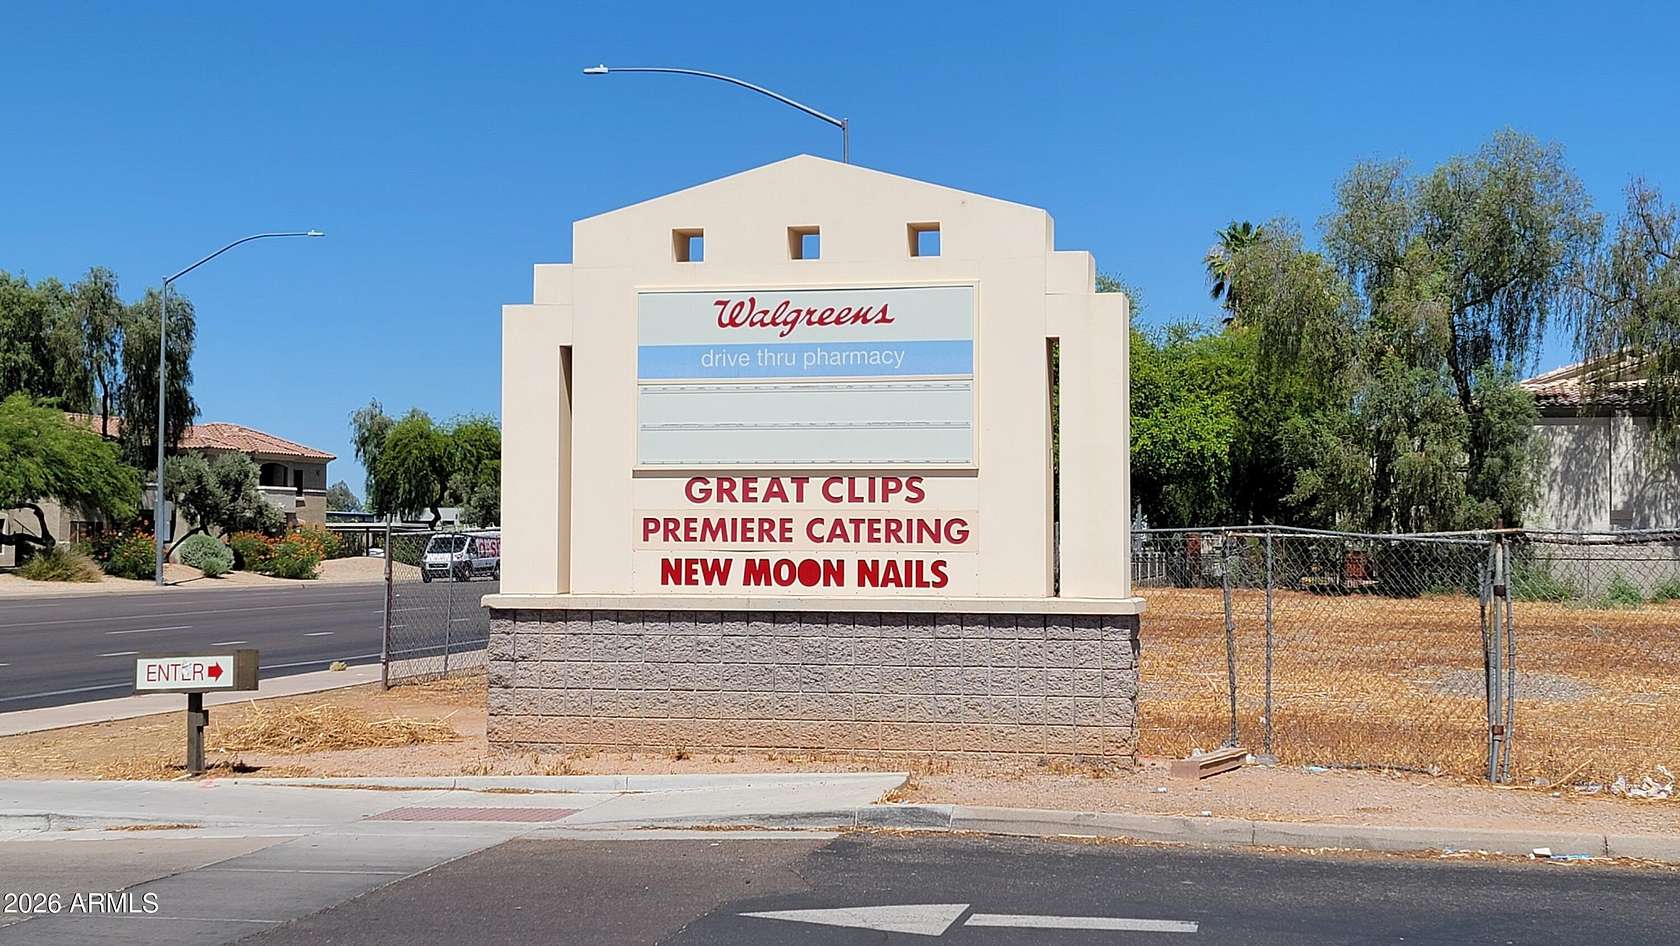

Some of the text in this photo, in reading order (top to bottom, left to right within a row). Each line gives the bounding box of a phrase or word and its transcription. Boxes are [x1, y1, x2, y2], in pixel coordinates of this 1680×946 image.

[713, 296, 896, 338] Walgreens
[701, 347, 905, 369] drive thru pharmacy
[684, 476, 926, 504] GREAT CLIPS
[642, 517, 971, 544] PREMIERE CATERING
[660, 558, 949, 589] NEW MOON NAILS
